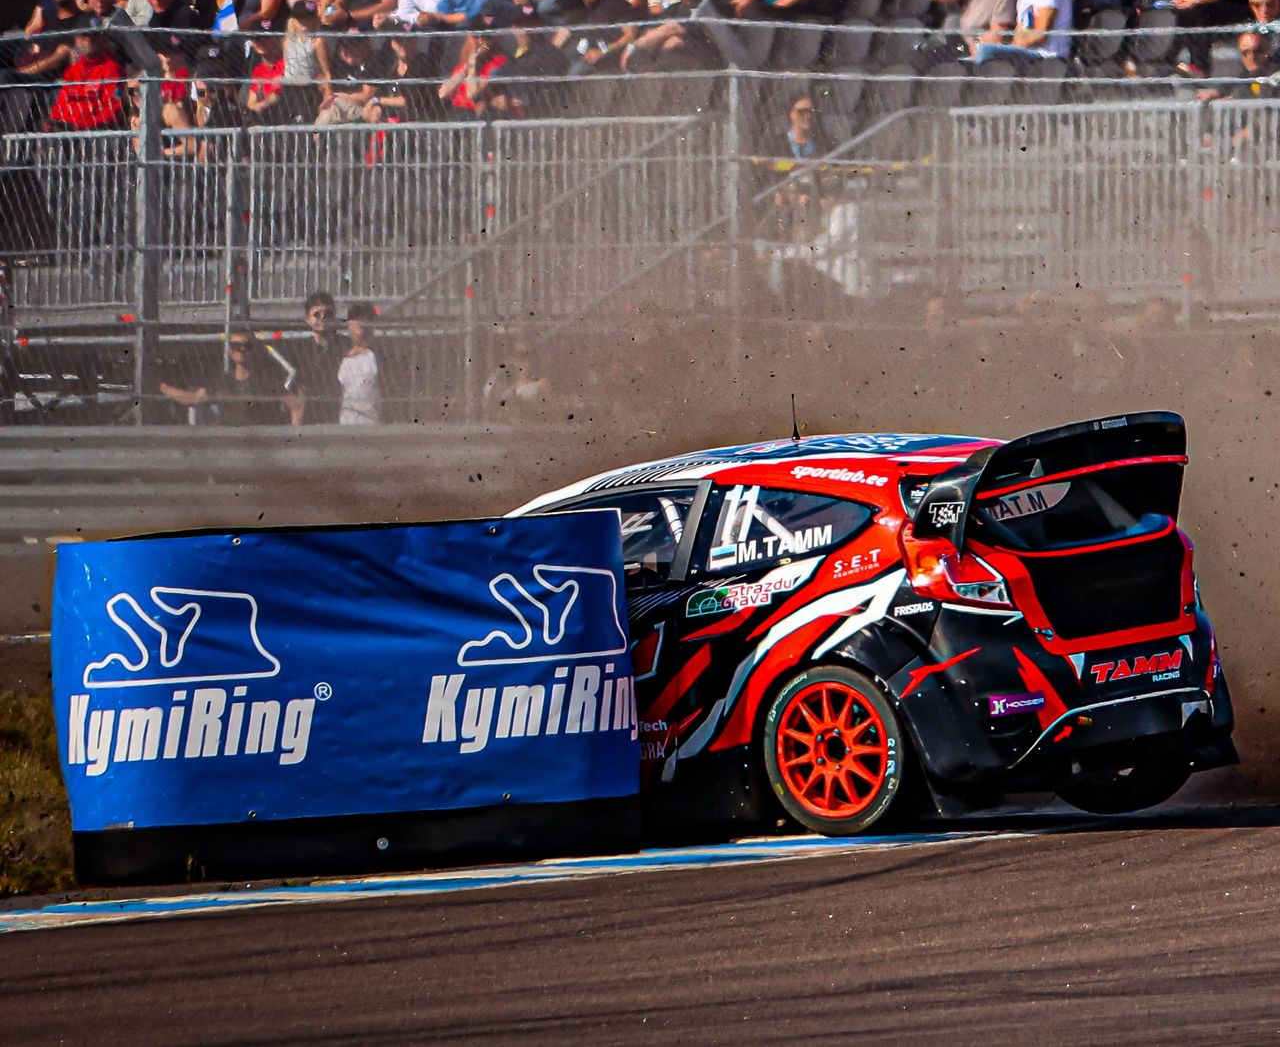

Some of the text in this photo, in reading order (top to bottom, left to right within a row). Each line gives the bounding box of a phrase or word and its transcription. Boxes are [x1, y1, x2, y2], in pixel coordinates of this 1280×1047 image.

[790, 465, 889, 487] sportlab.ee
[721, 484, 761, 545] 11
[736, 524, 833, 564] M.TAMM
[727, 577, 793, 598] Strazdu
[720, 591, 772, 610] Grava
[894, 601, 934, 617] FRISTADS
[1090, 649, 1184, 684] TAMM
[1151, 669, 1181, 682] RACING
[1005, 698, 1045, 710] HOOSIER
